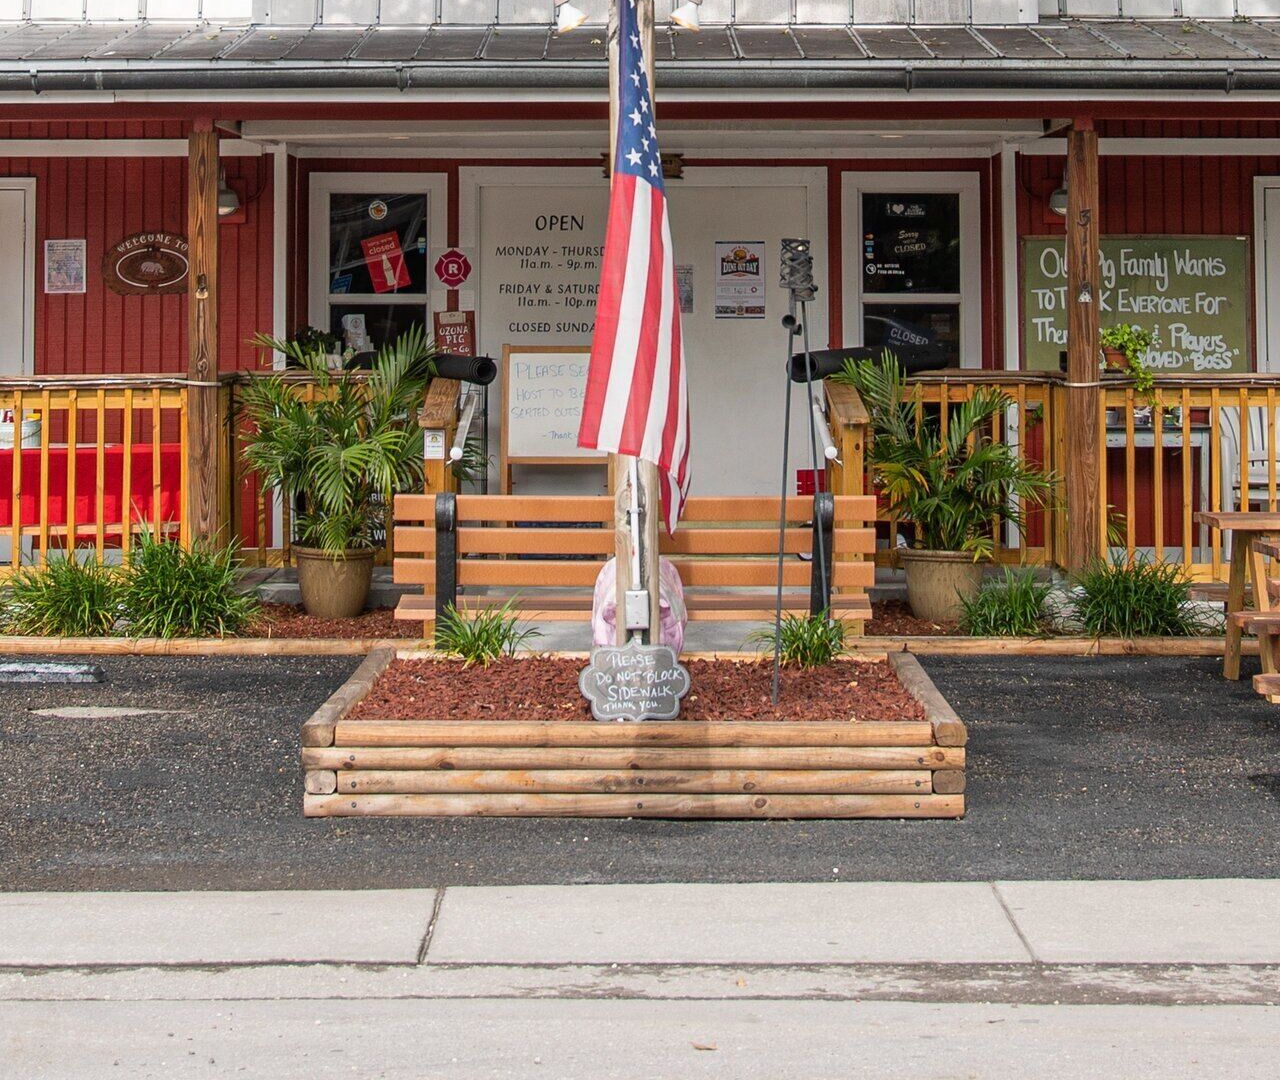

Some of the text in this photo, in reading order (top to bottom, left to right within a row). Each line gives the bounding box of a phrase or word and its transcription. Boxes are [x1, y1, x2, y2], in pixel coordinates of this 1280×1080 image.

[535, 215, 584, 231] OPEN
[117, 233, 189, 253] WELCOME TO
[369, 242, 395, 255] closed
[894, 243, 926, 253] CLOSED
[495, 246, 549, 257] MONDAY
[448, 263, 458, 274] R
[520, 259, 553, 269] 11a.m.
[567, 259, 598, 271] 9p.m.
[1120, 248, 1169, 292] Family
[1173, 248, 1227, 277] Wants
[499, 283, 541, 294] FRIDAY
[545, 284, 552, 294] &
[518, 296, 551, 307] 11a.m.
[1118, 288, 1192, 315] EVERYONE
[439, 325, 469, 336] OZONA
[508, 322, 551, 333] CLOSED
[446, 335, 465, 344] PIG
[890, 328, 929, 345] CLOSED
[1168, 322, 1227, 354] Prayers
[515, 362, 564, 380] PLEASE
[516, 388, 545, 402] HOST
[548, 388, 563, 399] TO
[510, 406, 551, 419] SEATED
[548, 430, 574, 440] Thank
[606, 652, 656, 668] PLEASE
[616, 670, 641, 682] NOT
[642, 669, 683, 684] BLOCK
[603, 701, 636, 712] THANK
